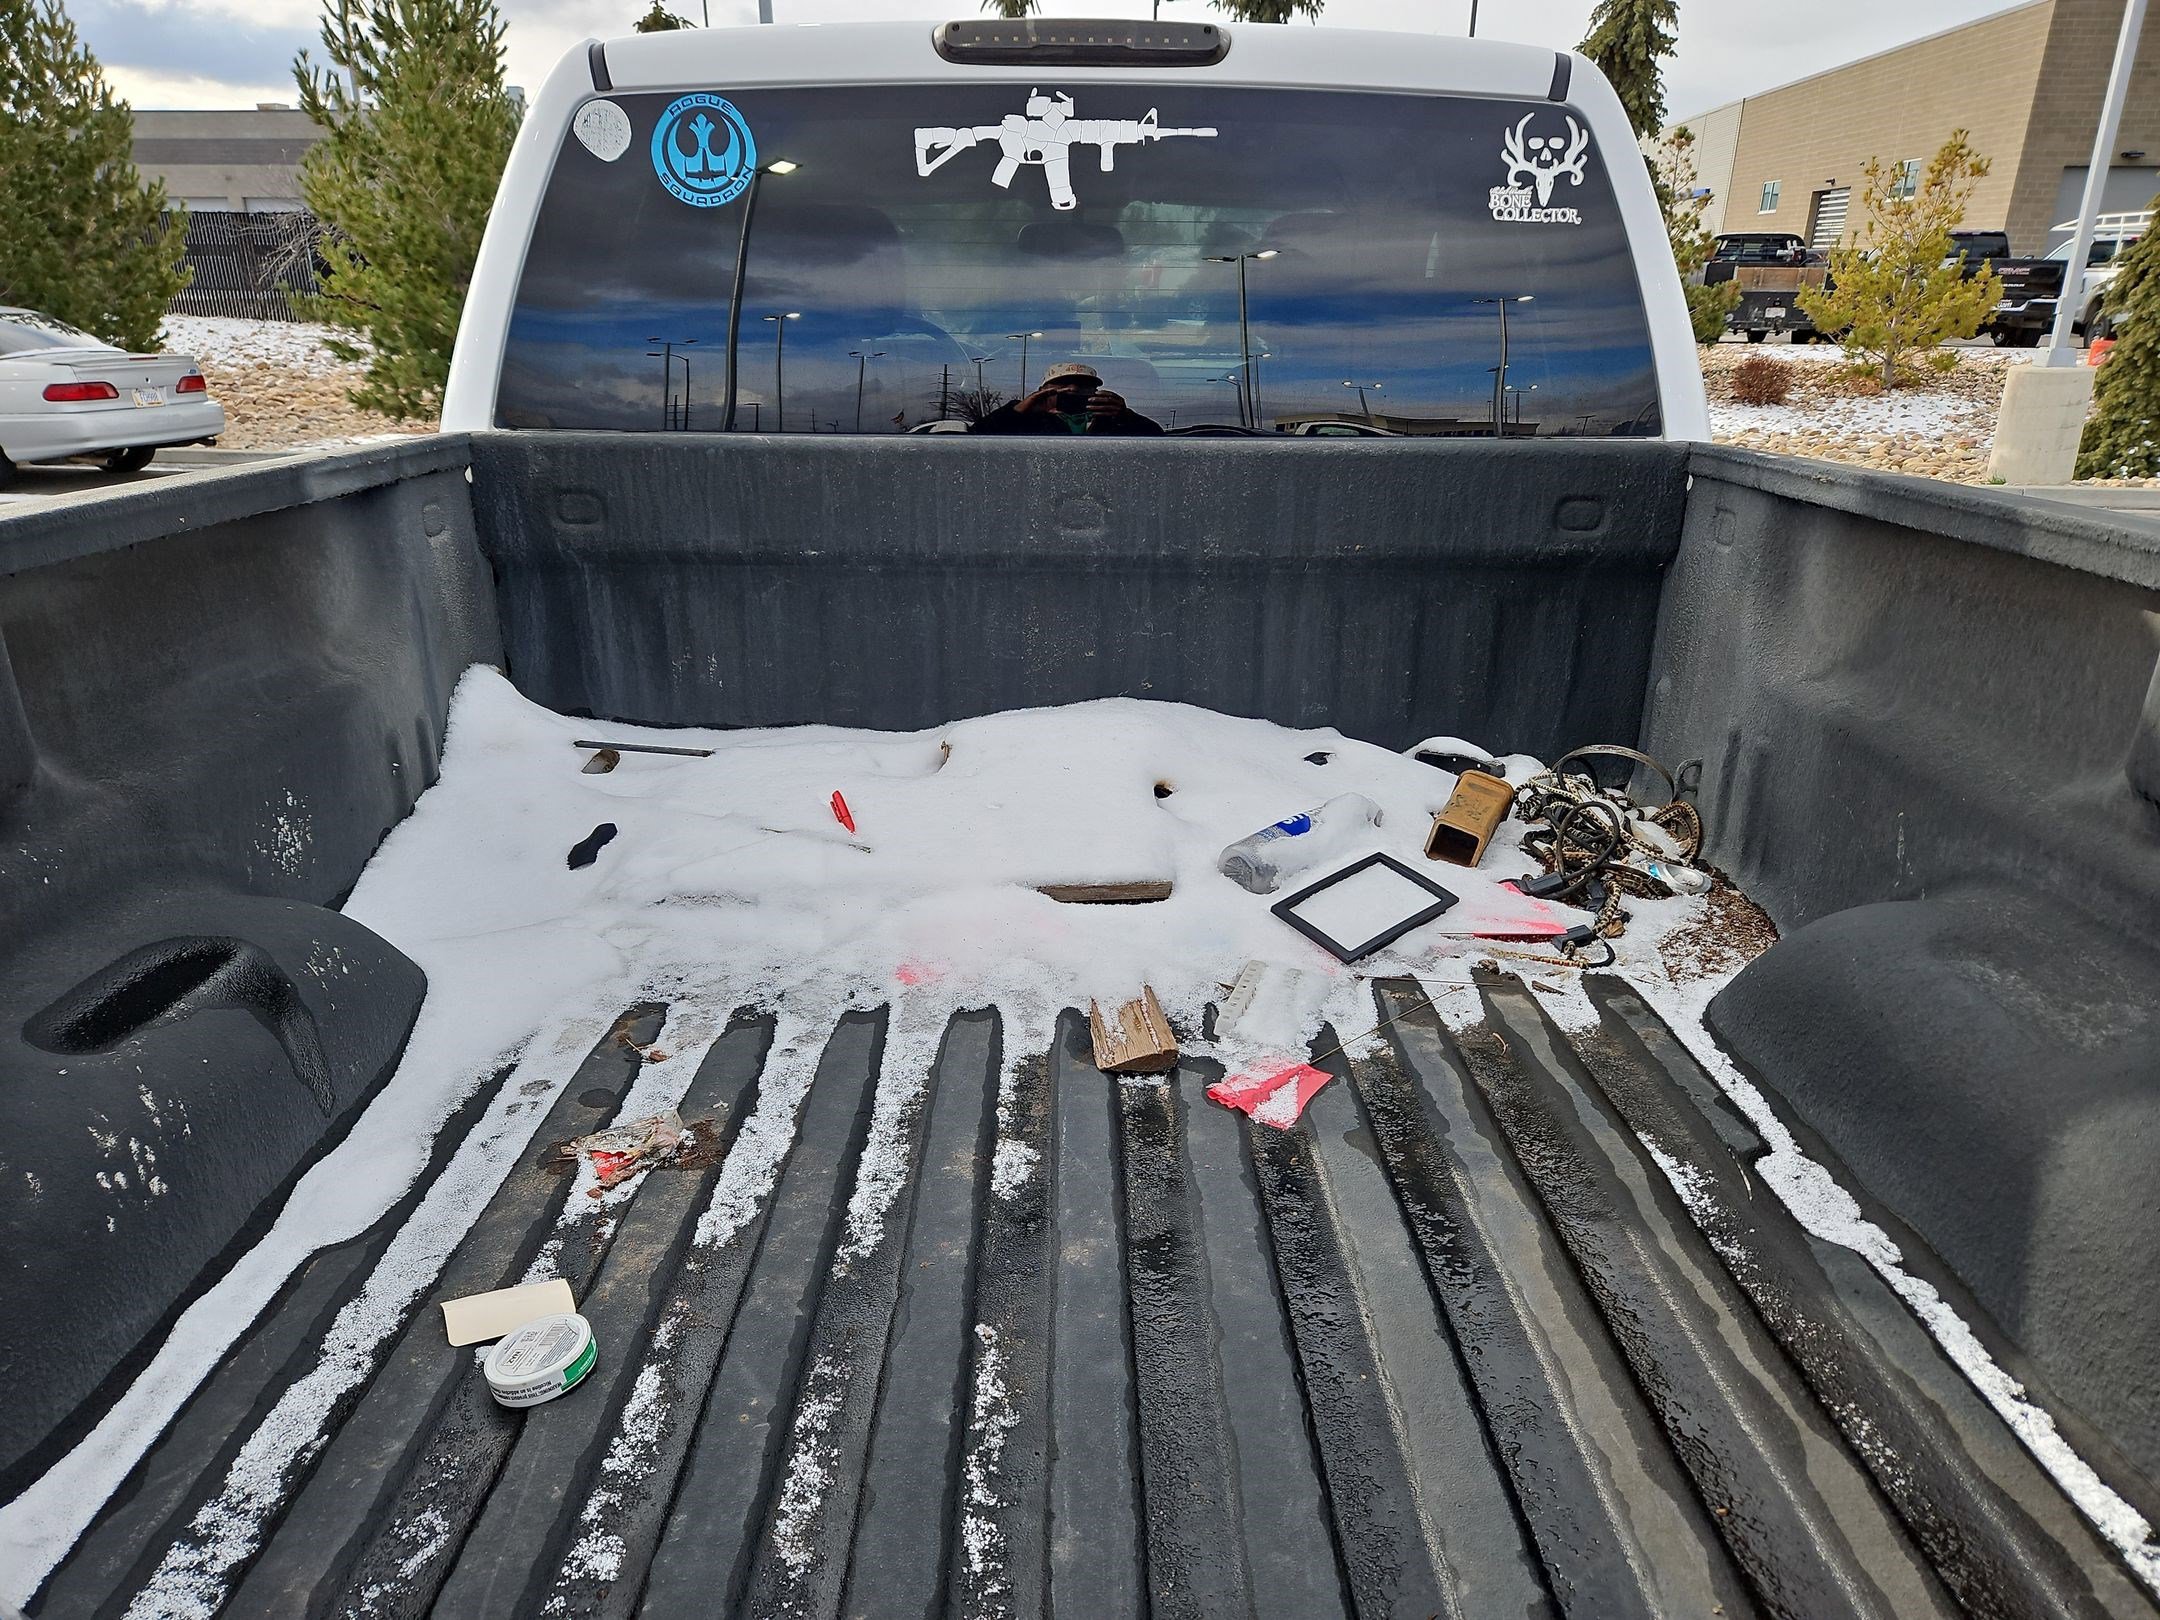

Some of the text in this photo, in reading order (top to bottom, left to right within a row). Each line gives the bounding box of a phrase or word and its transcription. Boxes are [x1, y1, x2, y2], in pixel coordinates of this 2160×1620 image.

[668, 95, 734, 116] ROGUE
[659, 165, 754, 206] SQUADRON
[1489, 194, 1532, 209] BONE
[1492, 207, 1582, 225] COLLECTOR
